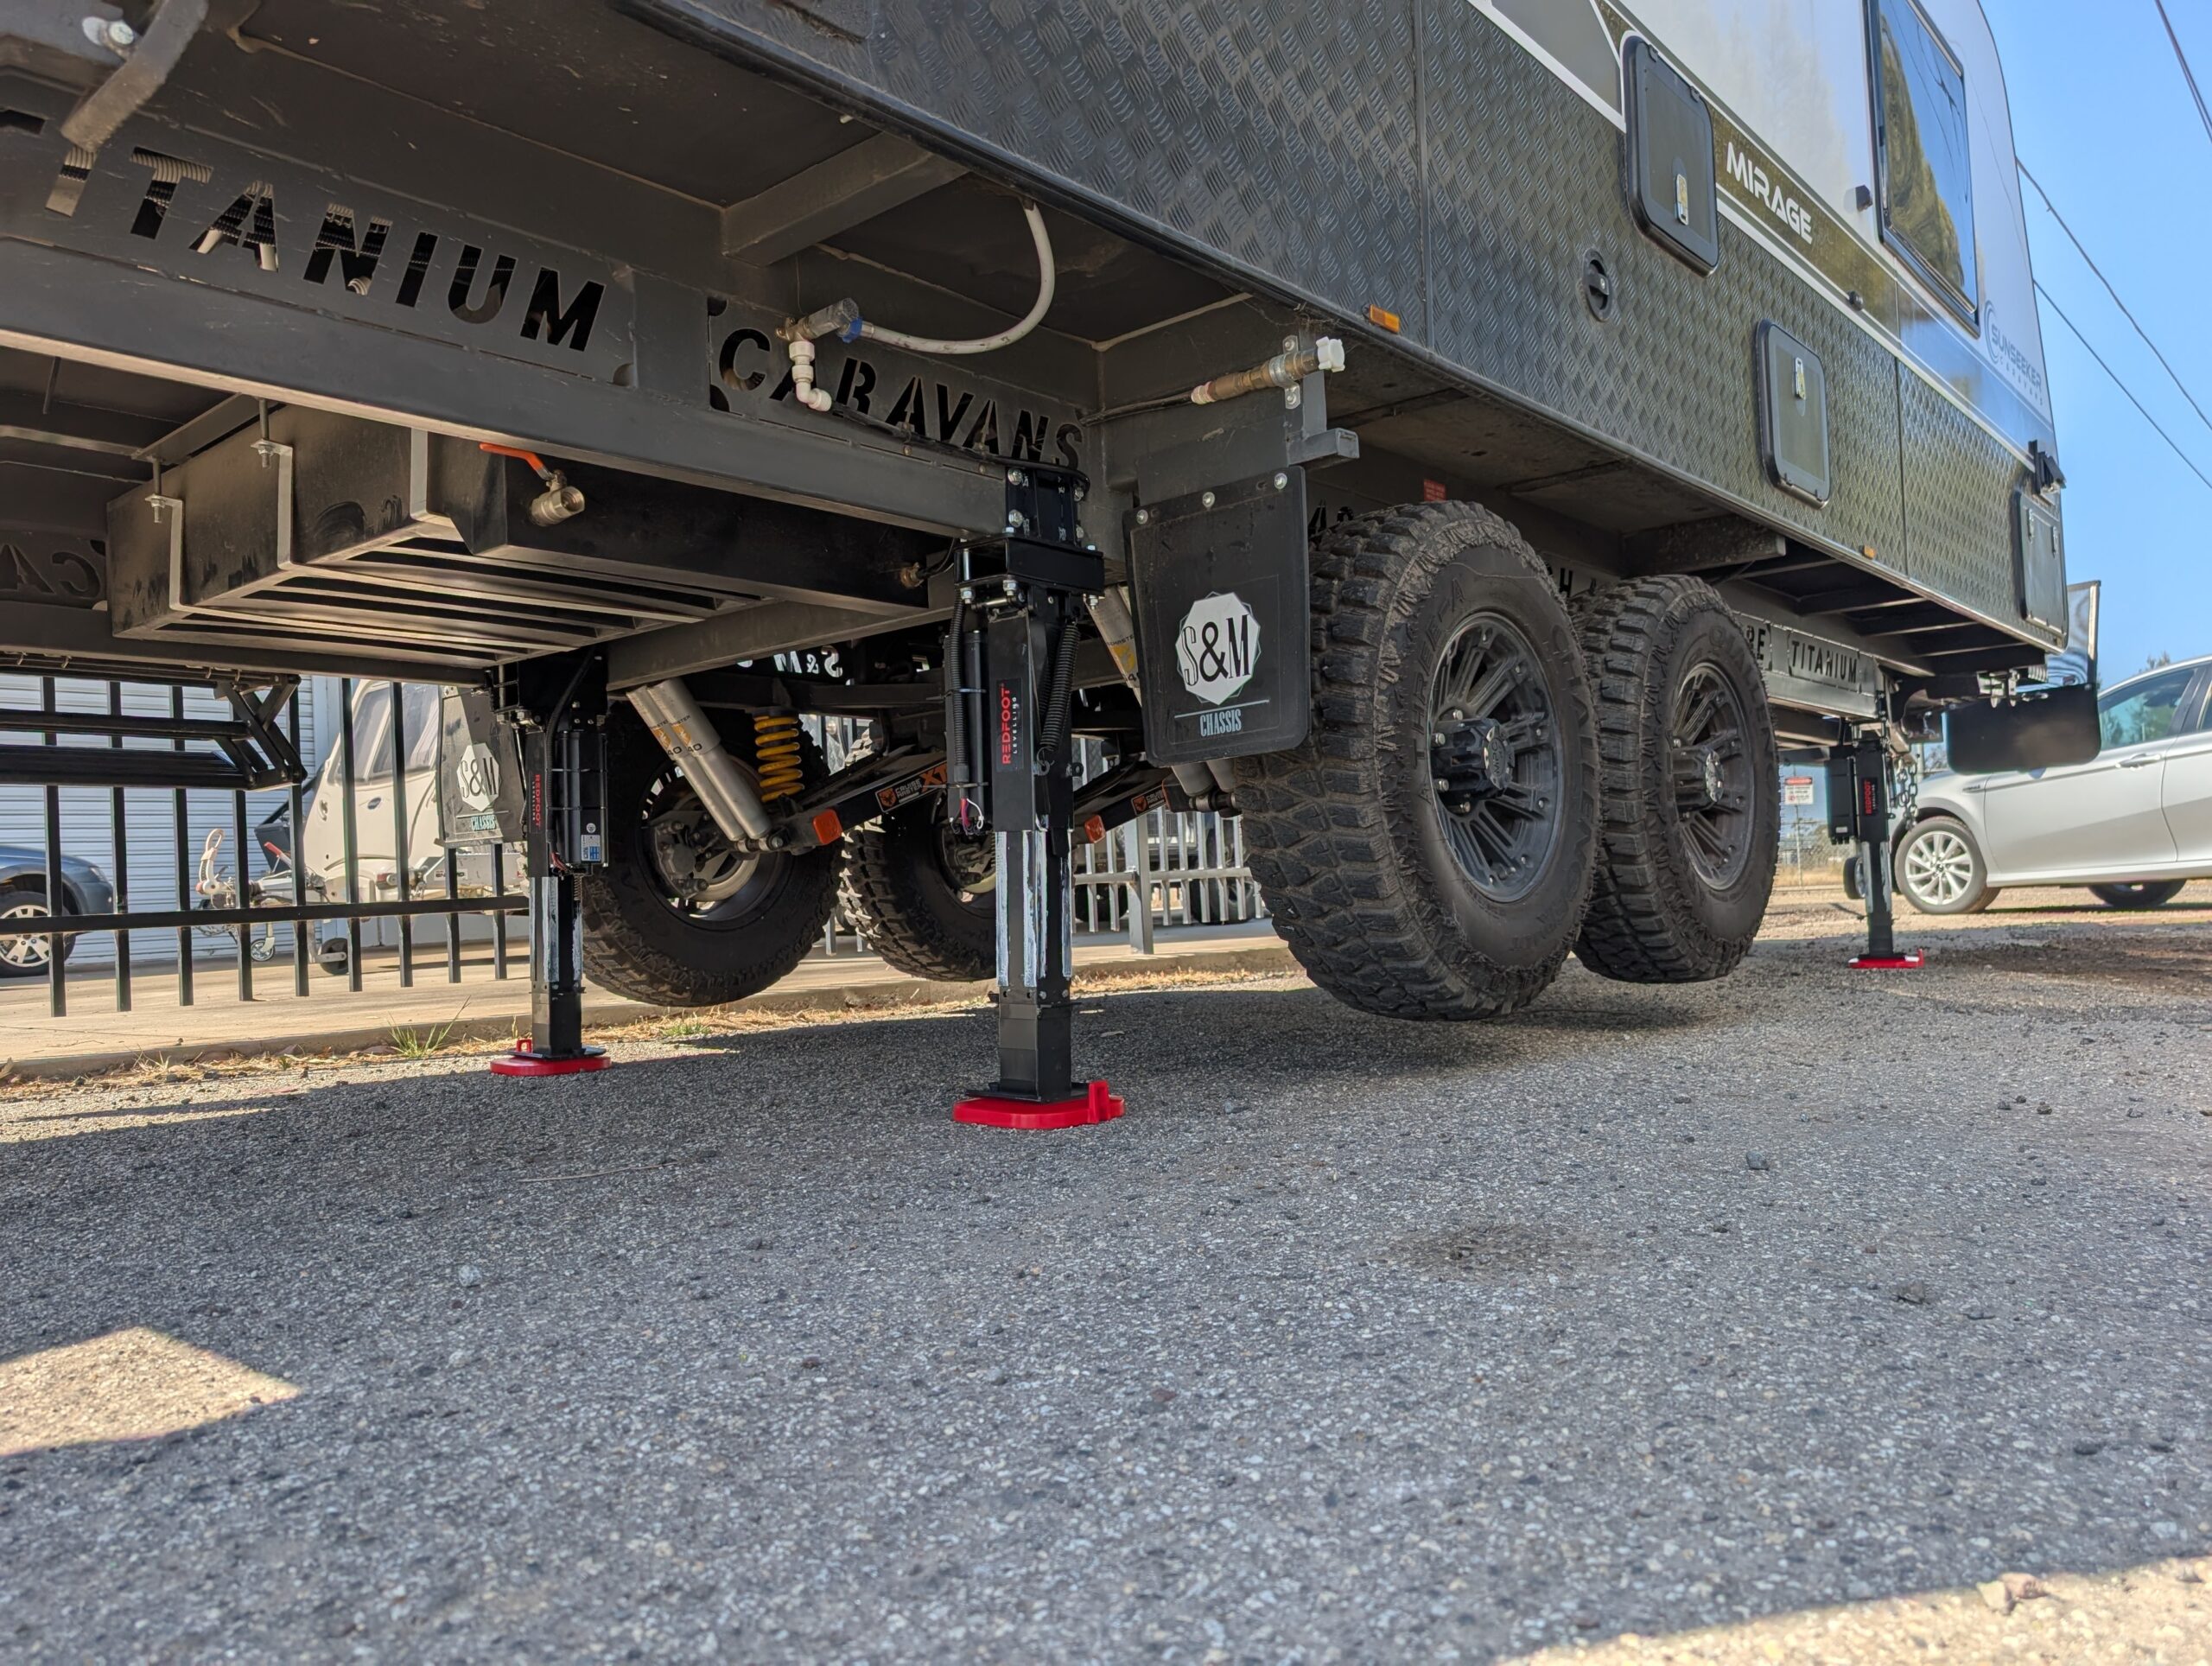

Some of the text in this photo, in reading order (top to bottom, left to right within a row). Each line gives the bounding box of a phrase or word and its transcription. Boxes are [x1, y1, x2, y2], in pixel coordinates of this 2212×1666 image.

[1726, 141, 1813, 245] MIRAGE
[0, 108, 605, 352] ITANIUM
[1991, 323, 2042, 392] SUNSEEKER
[1183, 614, 1251, 687] S&M
[1791, 640, 1858, 684] TITANIUM
[1001, 687, 1011, 764] REDFOOT
[1199, 708, 1243, 737] CHASSIS
[461, 756, 498, 798] S&M
[471, 814, 497, 831] CHASSIS
